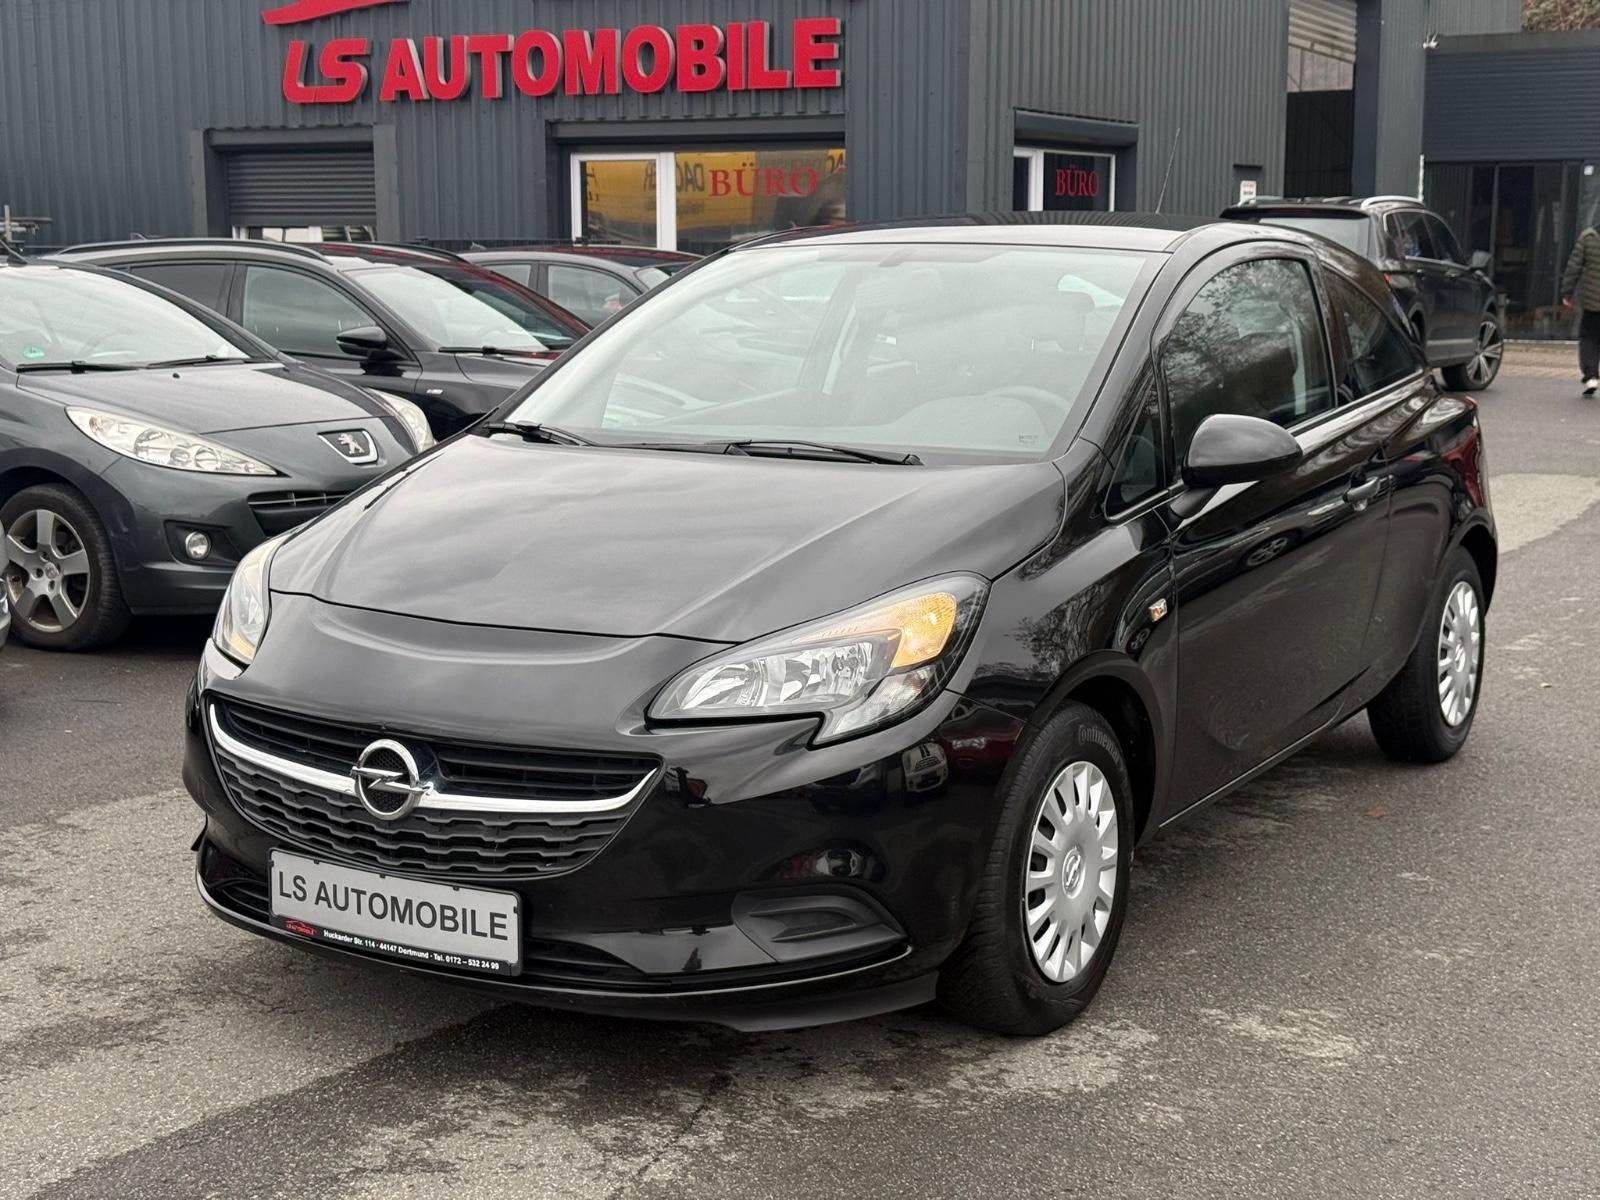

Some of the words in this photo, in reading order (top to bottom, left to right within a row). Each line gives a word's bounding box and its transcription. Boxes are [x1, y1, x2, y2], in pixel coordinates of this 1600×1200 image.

[282, 38, 369, 103] LS
[380, 18, 841, 102] AUTOMOBILE
[708, 162, 819, 197] BÜRO
[1055, 164, 1099, 197] BÜRO
[278, 871, 308, 901] LS
[314, 880, 508, 941] AUTOMOBILE
[323, 929, 354, 943] Huckarder
[353, 936, 364, 946] Str.
[364, 939, 375, 948] 114
[379, 941, 397, 952] 44147
[398, 946, 429, 959] Dortmund
[433, 953, 445, 962] Tel.
[445, 955, 461, 964] 0172
[468, 958, 480, 967] 532
[481, 960, 490, 969] 24
